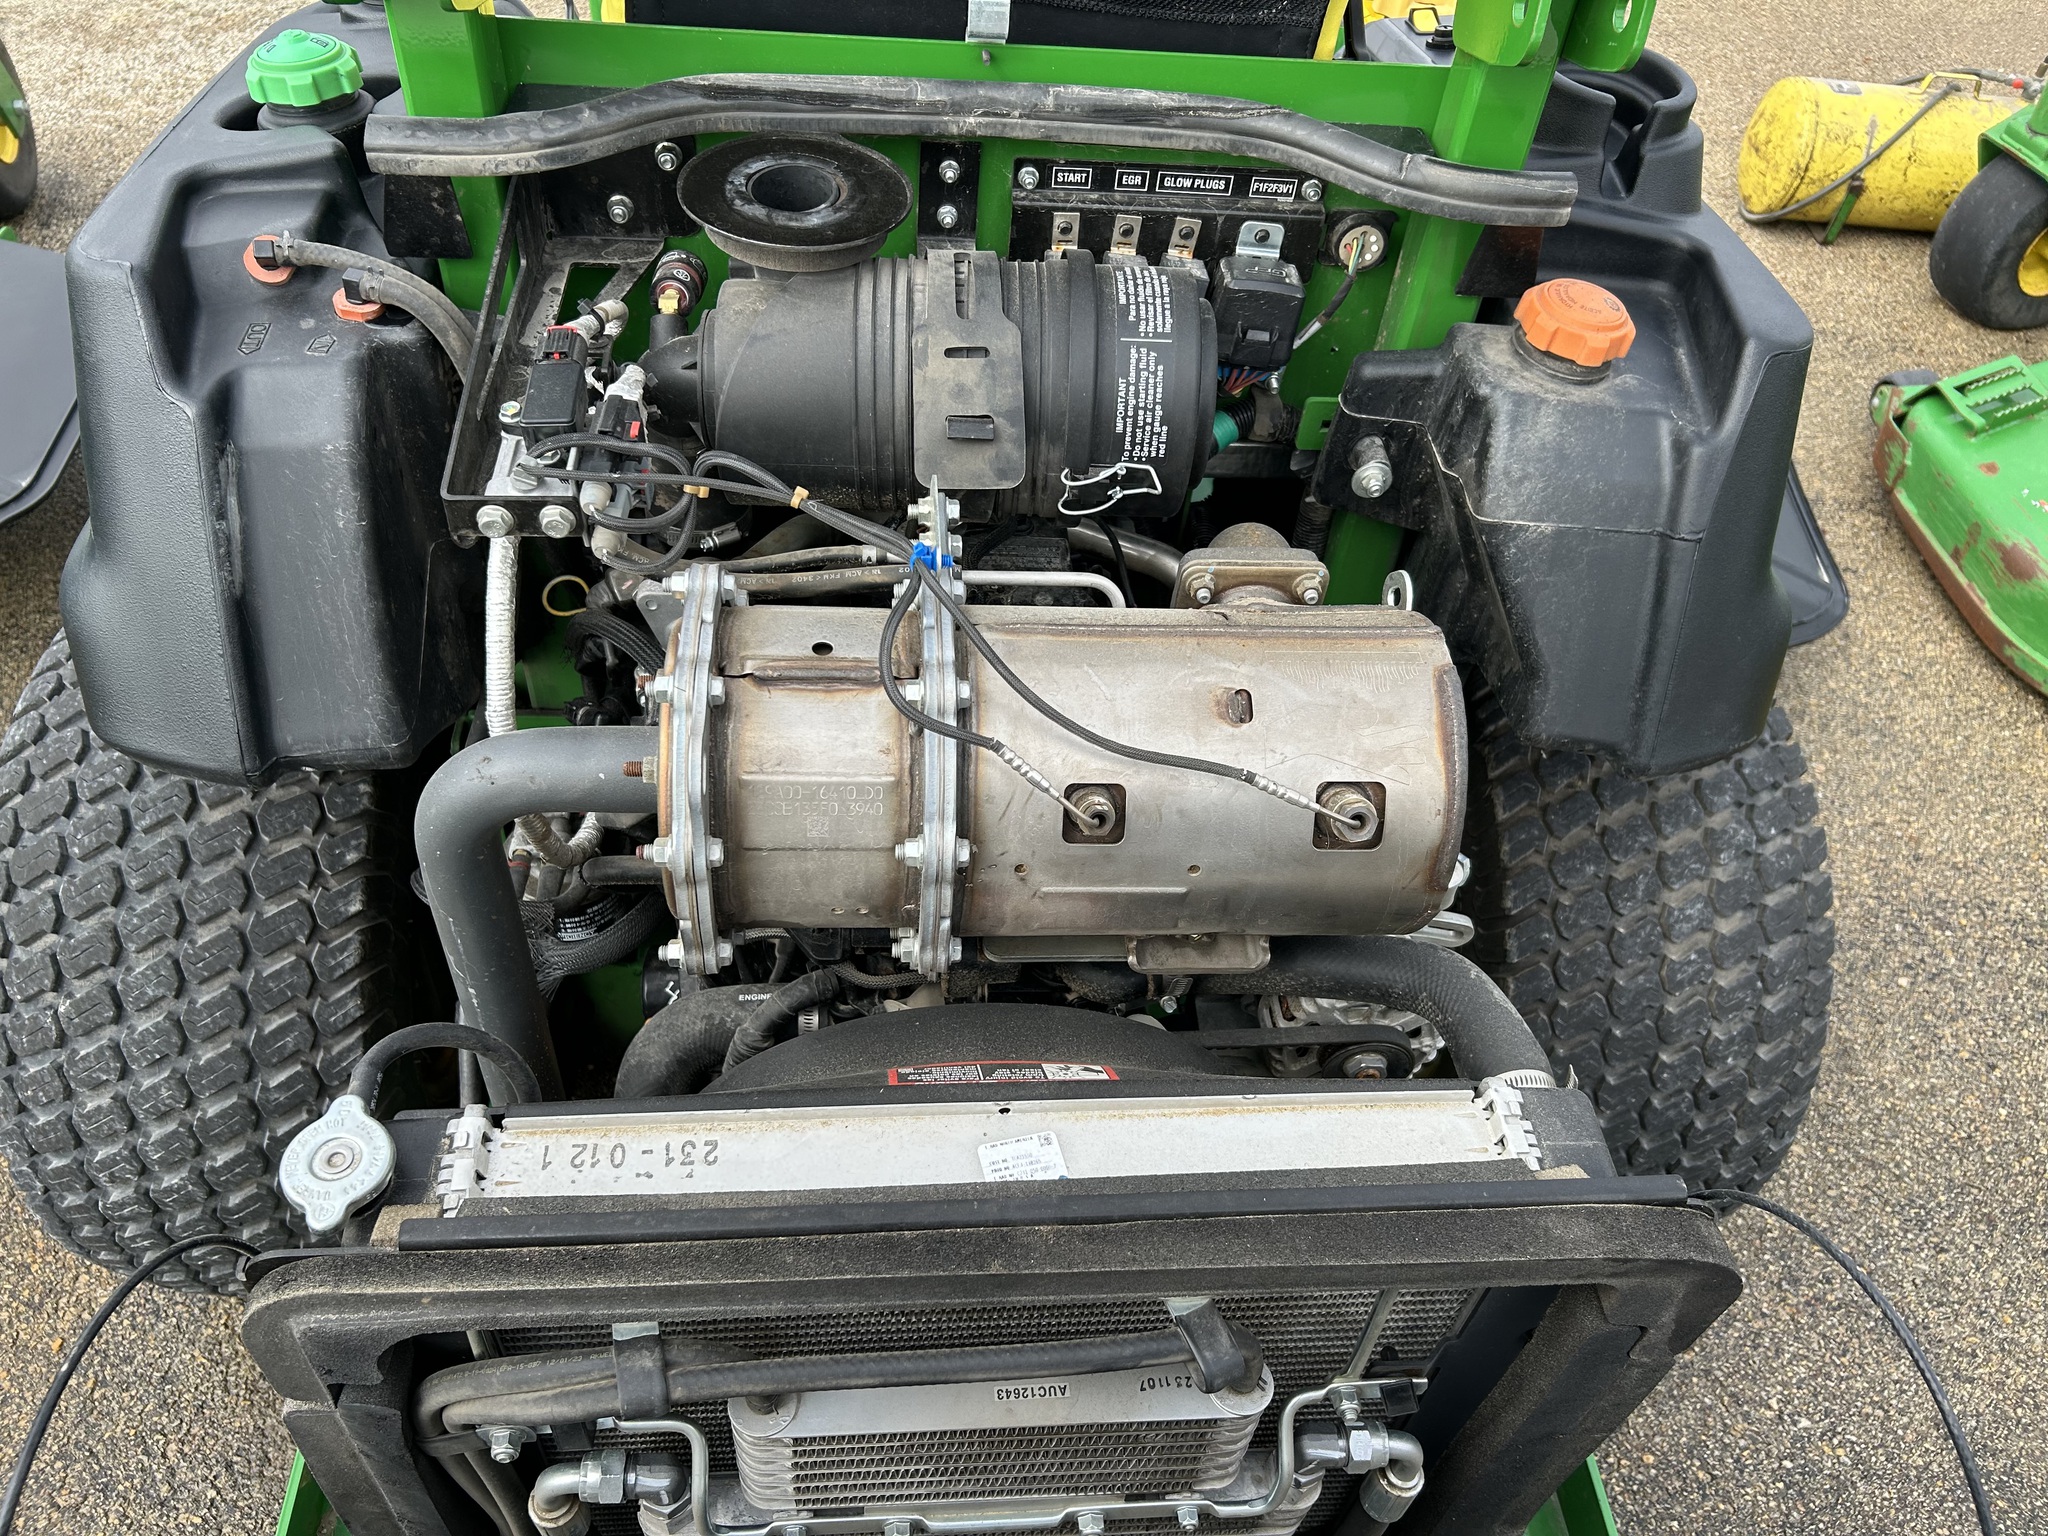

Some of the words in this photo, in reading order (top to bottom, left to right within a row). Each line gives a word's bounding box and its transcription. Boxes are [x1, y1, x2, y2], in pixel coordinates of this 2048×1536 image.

[1057, 172, 1087, 183] START
[1122, 174, 1142, 185] EGR
[1164, 177, 1193, 188] GLOW
[1194, 178, 1226, 190] PLUGS
[1252, 182, 1293, 194] F1F2F3V1
[1130, 295, 1136, 303] no
[1139, 321, 1146, 331] No
[1164, 310, 1172, 332] llegue
[242, 325, 267, 348] OUT
[1128, 345, 1138, 383] damage:
[1139, 348, 1147, 368] fluid
[1148, 351, 1157, 371] only
[1137, 371, 1148, 407] starting
[1146, 374, 1155, 408] cleaner
[1154, 365, 1163, 402] reaches
[1116, 377, 1126, 432] IMPORTANT
[1127, 385, 1136, 416] engine
[1154, 405, 1162, 432] gauge
[1124, 418, 1134, 449] prevent
[1134, 429, 1142, 442] not
[1141, 425, 1151, 457] Service
[1159, 425, 1168, 441] line
[1133, 445, 1140, 456] Do
[1150, 435, 1158, 457] when
[1158, 444, 1166, 457] red
[1121, 452, 1129, 461] To
[996, 1384, 1068, 1400] AUC12643
